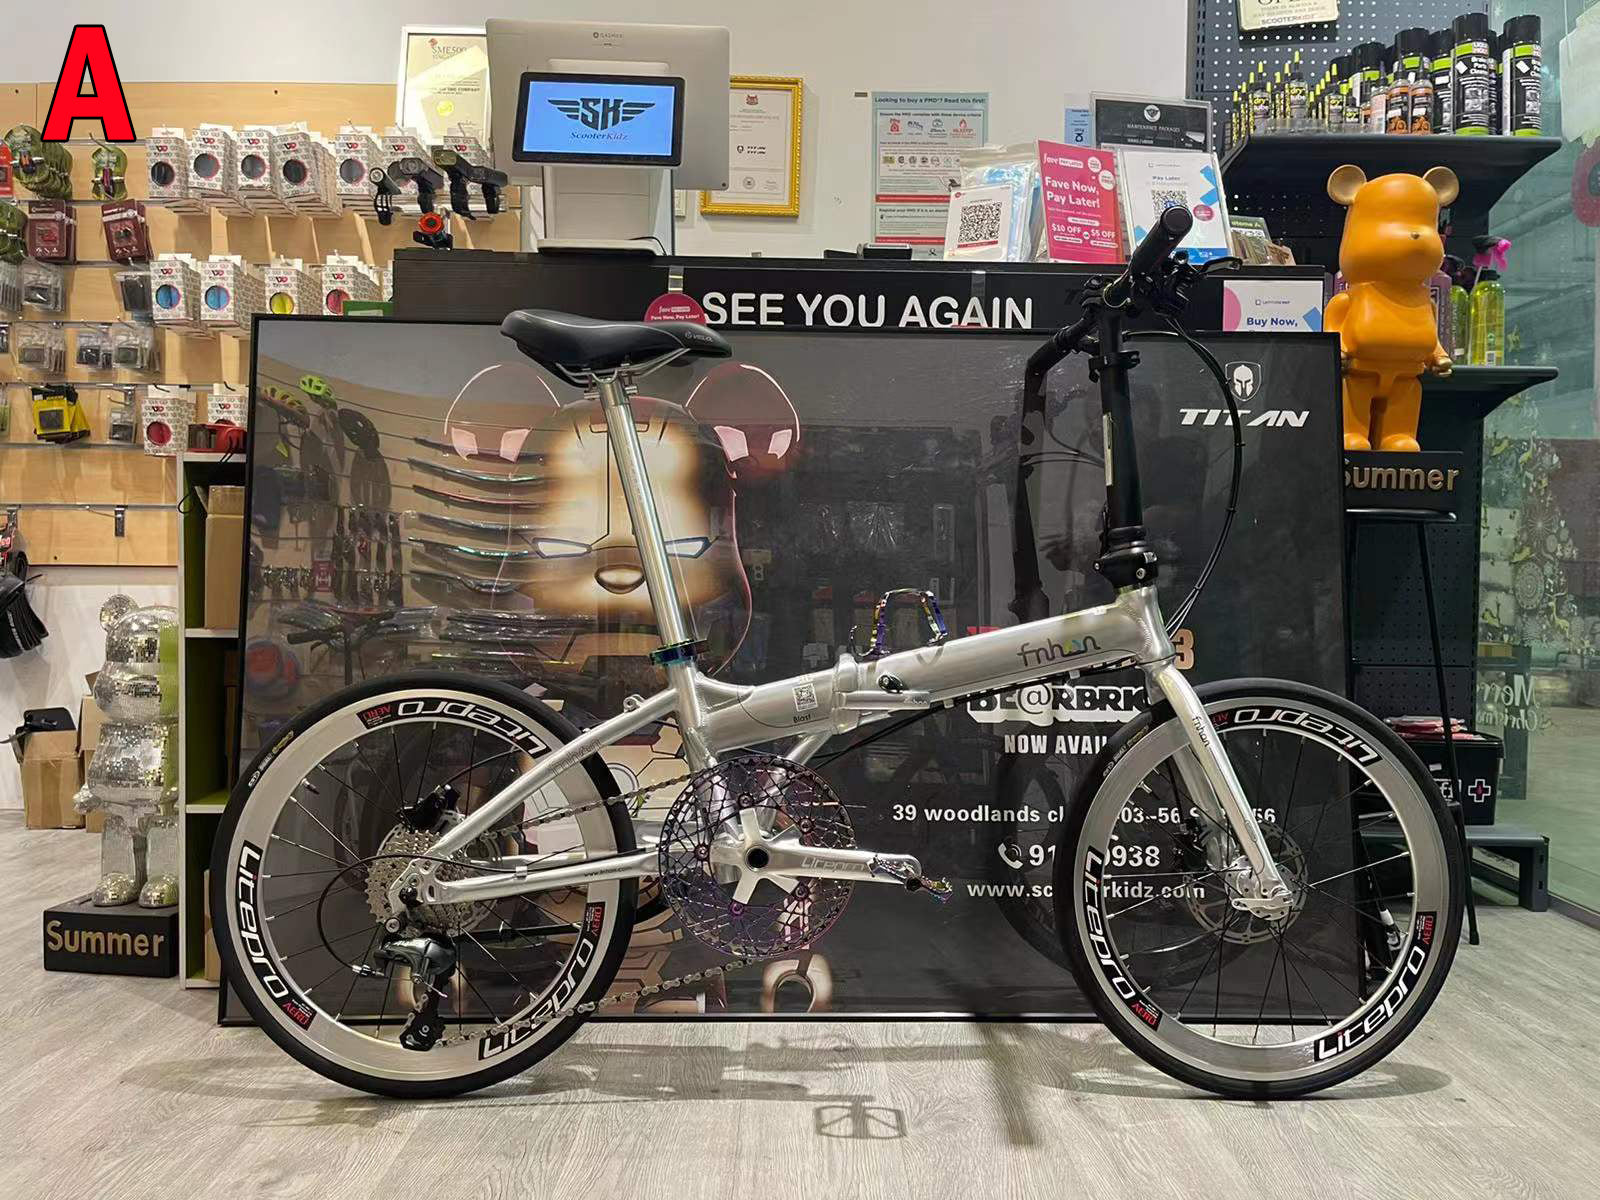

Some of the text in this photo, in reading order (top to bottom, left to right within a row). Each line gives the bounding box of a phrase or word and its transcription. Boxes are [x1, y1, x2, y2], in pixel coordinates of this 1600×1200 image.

[570, 131, 629, 141] ScooterKidz
[1045, 176, 1099, 195] Fave Now,
[1047, 191, 1100, 208] Pay Later!
[1052, 223, 1081, 233] $10 OFF
[1091, 229, 1116, 238] $5 OFF
[703, 291, 1032, 329] SEE YOU AGAIN
[1246, 317, 1298, 327] Buy Now,
[1179, 408, 1309, 427] TITAN
[1004, 734, 1048, 755] NOW
[893, 804, 917, 821] 39
[924, 804, 1040, 822] woodlands
[46, 920, 165, 957] Summer
